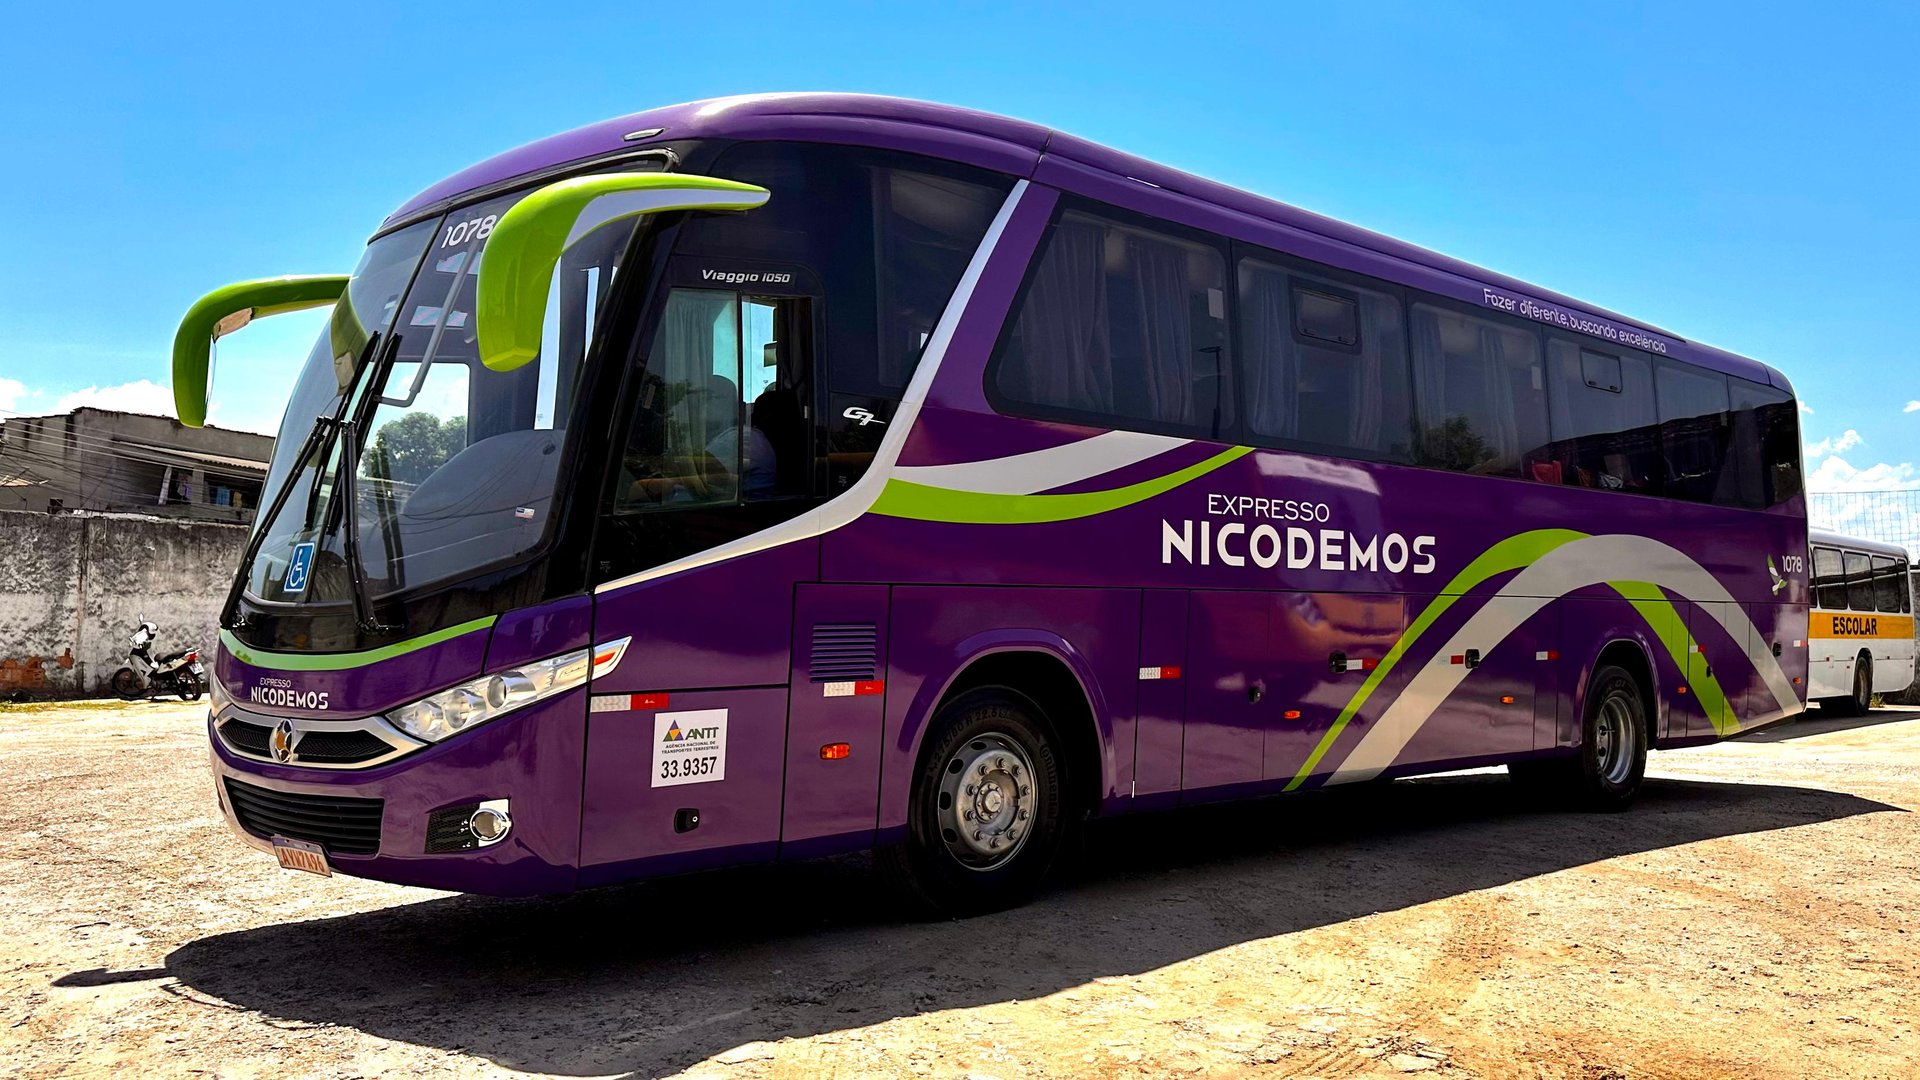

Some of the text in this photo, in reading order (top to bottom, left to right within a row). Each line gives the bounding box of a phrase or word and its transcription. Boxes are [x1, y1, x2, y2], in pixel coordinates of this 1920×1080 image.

[441, 214, 497, 249] 1078
[702, 269, 791, 283] Viaggio 1050
[1483, 288, 1516, 312] Fazer
[1618, 328, 1667, 354] excelência
[1207, 493, 1330, 523] EXPRESSO
[1162, 518, 1436, 574] NICODEMOS
[1782, 555, 1803, 573] 1078
[1832, 616, 1878, 635] ESCOLAR
[260, 677, 292, 688] EXPRESSO
[251, 686, 329, 710] NICODEMOS
[685, 726, 719, 741] ANTT
[661, 756, 717, 779] 33.9357
